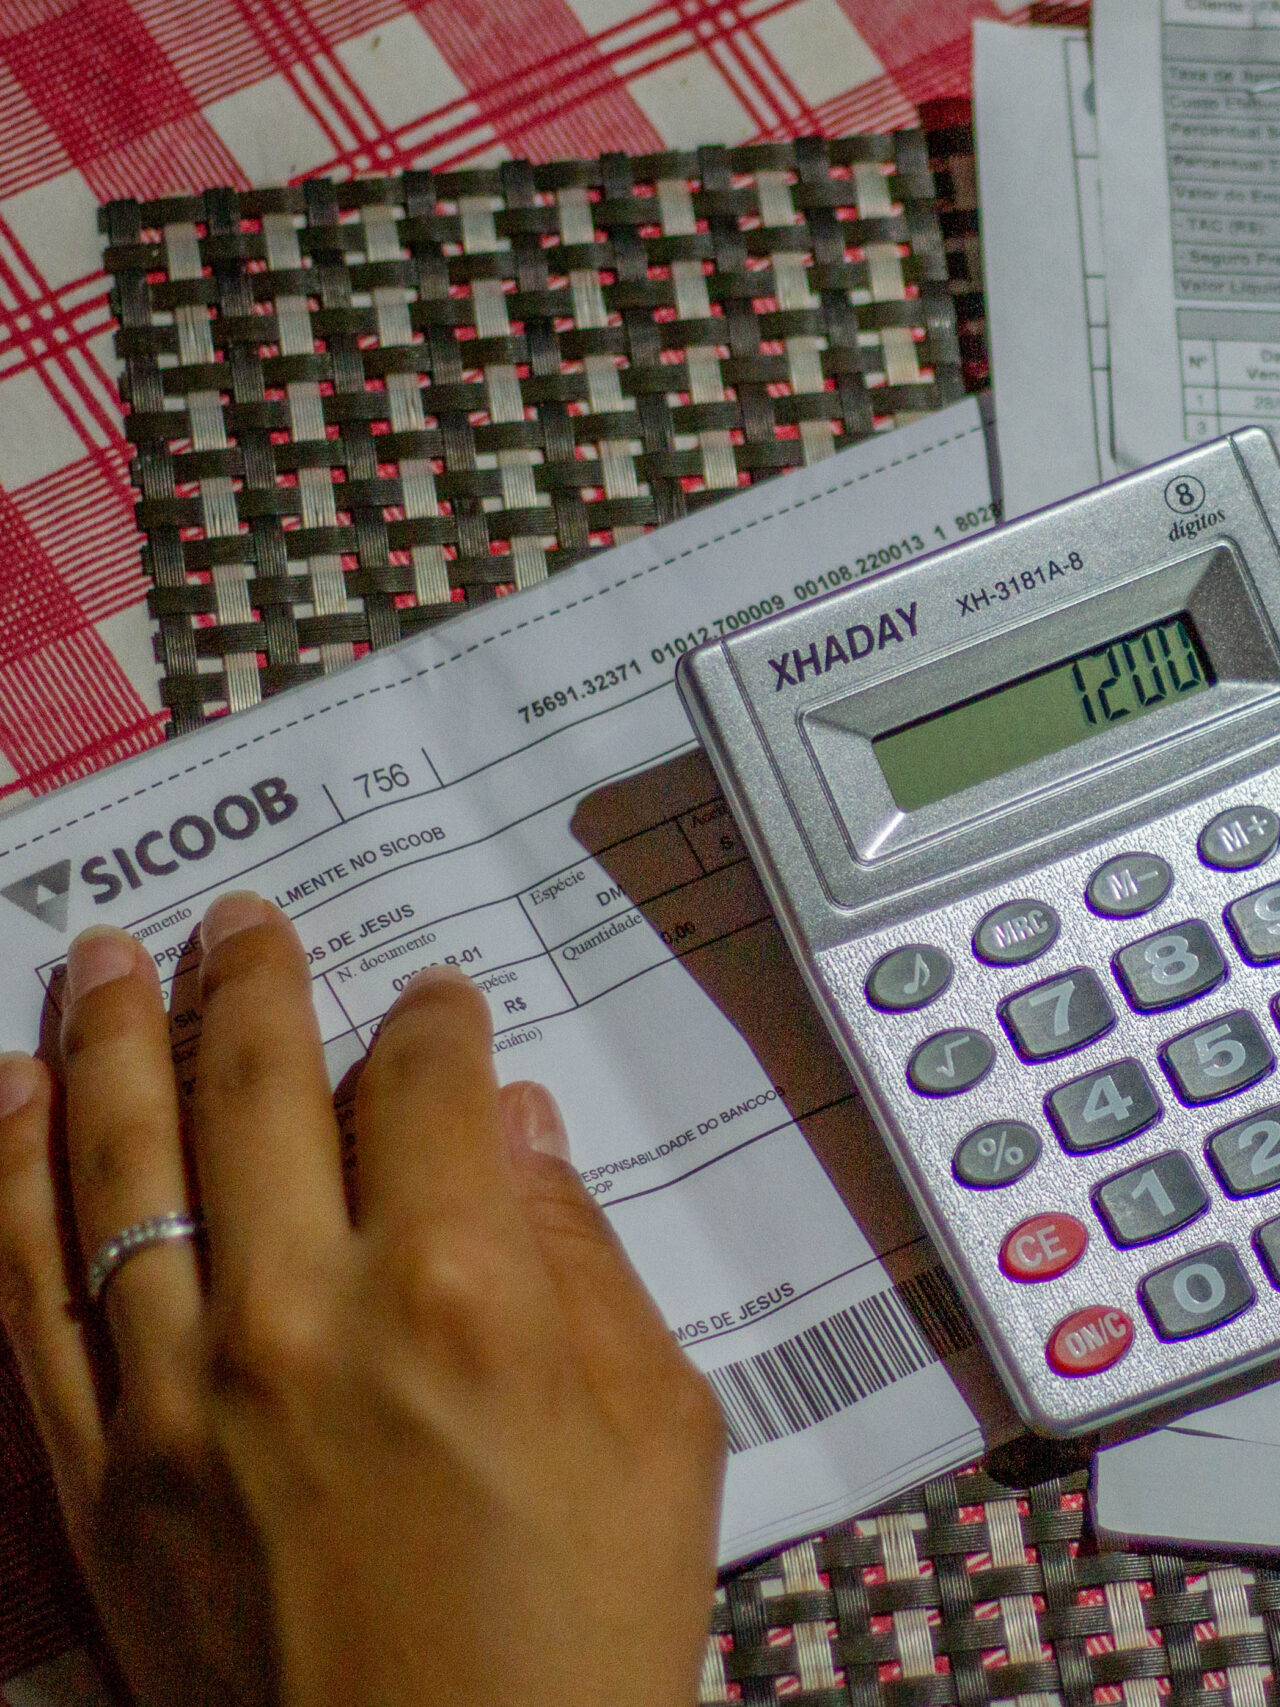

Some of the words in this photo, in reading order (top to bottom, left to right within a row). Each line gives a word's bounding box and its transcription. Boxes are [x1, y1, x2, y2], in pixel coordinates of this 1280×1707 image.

[1167, 506, 1228, 544] dígitos
[517, 657, 643, 727] 75691.32371
[649, 593, 786, 666] 01012.700009
[792, 534, 926, 602] 00108.220013
[768, 600, 921, 694] XHADAY
[954, 550, 1086, 619] XH-3181A-8
[1070, 618, 1204, 727] 1200
[353, 762, 411, 799] 756
[79, 775, 300, 906] SICOOB
[153, 937, 202, 969] PREF
[275, 863, 349, 911] LMENTE
[349, 849, 378, 872] NO
[379, 825, 447, 858] SICOOB
[528, 867, 587, 907] Espécie
[595, 882, 627, 908] DM
[132, 906, 193, 946] gamento
[328, 931, 356, 954] DE
[358, 903, 416, 939] JESUS
[561, 910, 643, 963] Quantidade
[992, 908, 1049, 950] MRC
[359, 930, 438, 974] documento
[1143, 934, 1200, 987] 8
[476, 967, 519, 994] spécie
[503, 996, 528, 1015] R$
[1027, 979, 1077, 1038] 7
[1192, 1022, 1248, 1078] 5
[1081, 1073, 1134, 1123] 4
[580, 1129, 697, 1184] ESPONSABILIDADE
[696, 1116, 719, 1138] DO
[1129, 1168, 1177, 1218] 1
[1013, 1224, 1068, 1269] CE
[710, 1310, 736, 1333] DE
[738, 1280, 796, 1322] JESUS
[1171, 1261, 1227, 1315] 0
[1063, 1310, 1128, 1361] ON/C
